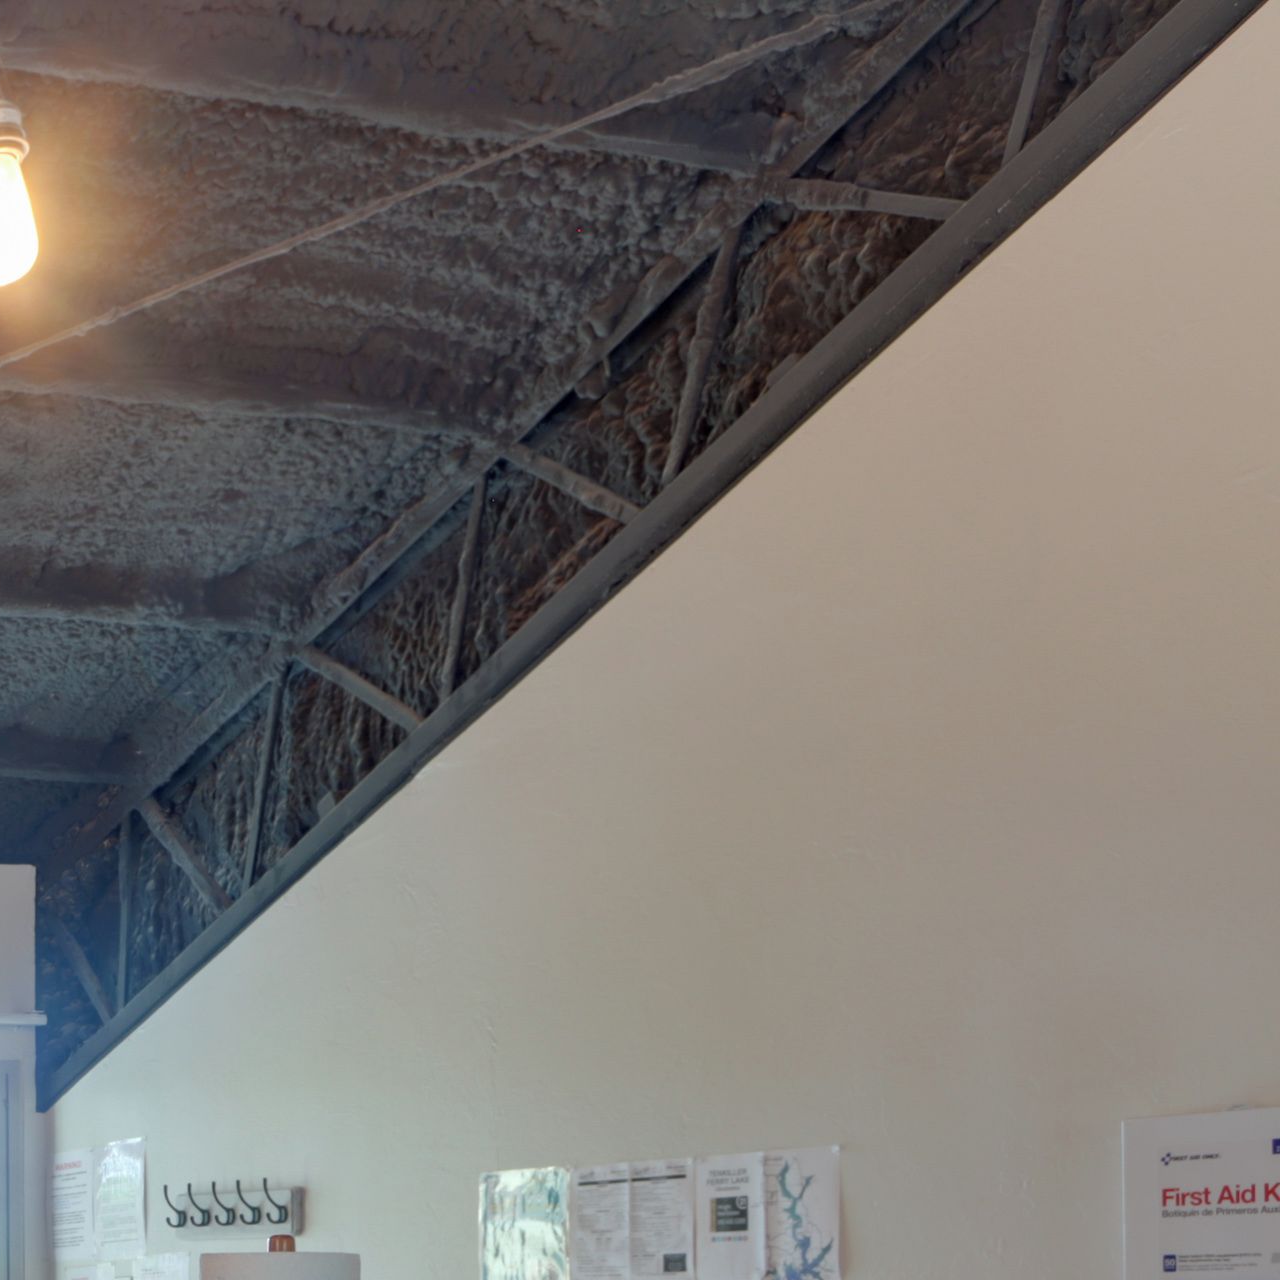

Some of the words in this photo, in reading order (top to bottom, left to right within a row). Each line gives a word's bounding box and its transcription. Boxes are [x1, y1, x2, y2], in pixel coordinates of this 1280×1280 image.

[1162, 1187, 1211, 1207] First
[1217, 1183, 1256, 1205] Aid
[1201, 1209, 1214, 1217] de
[1215, 1206, 1259, 1216] Primeros
